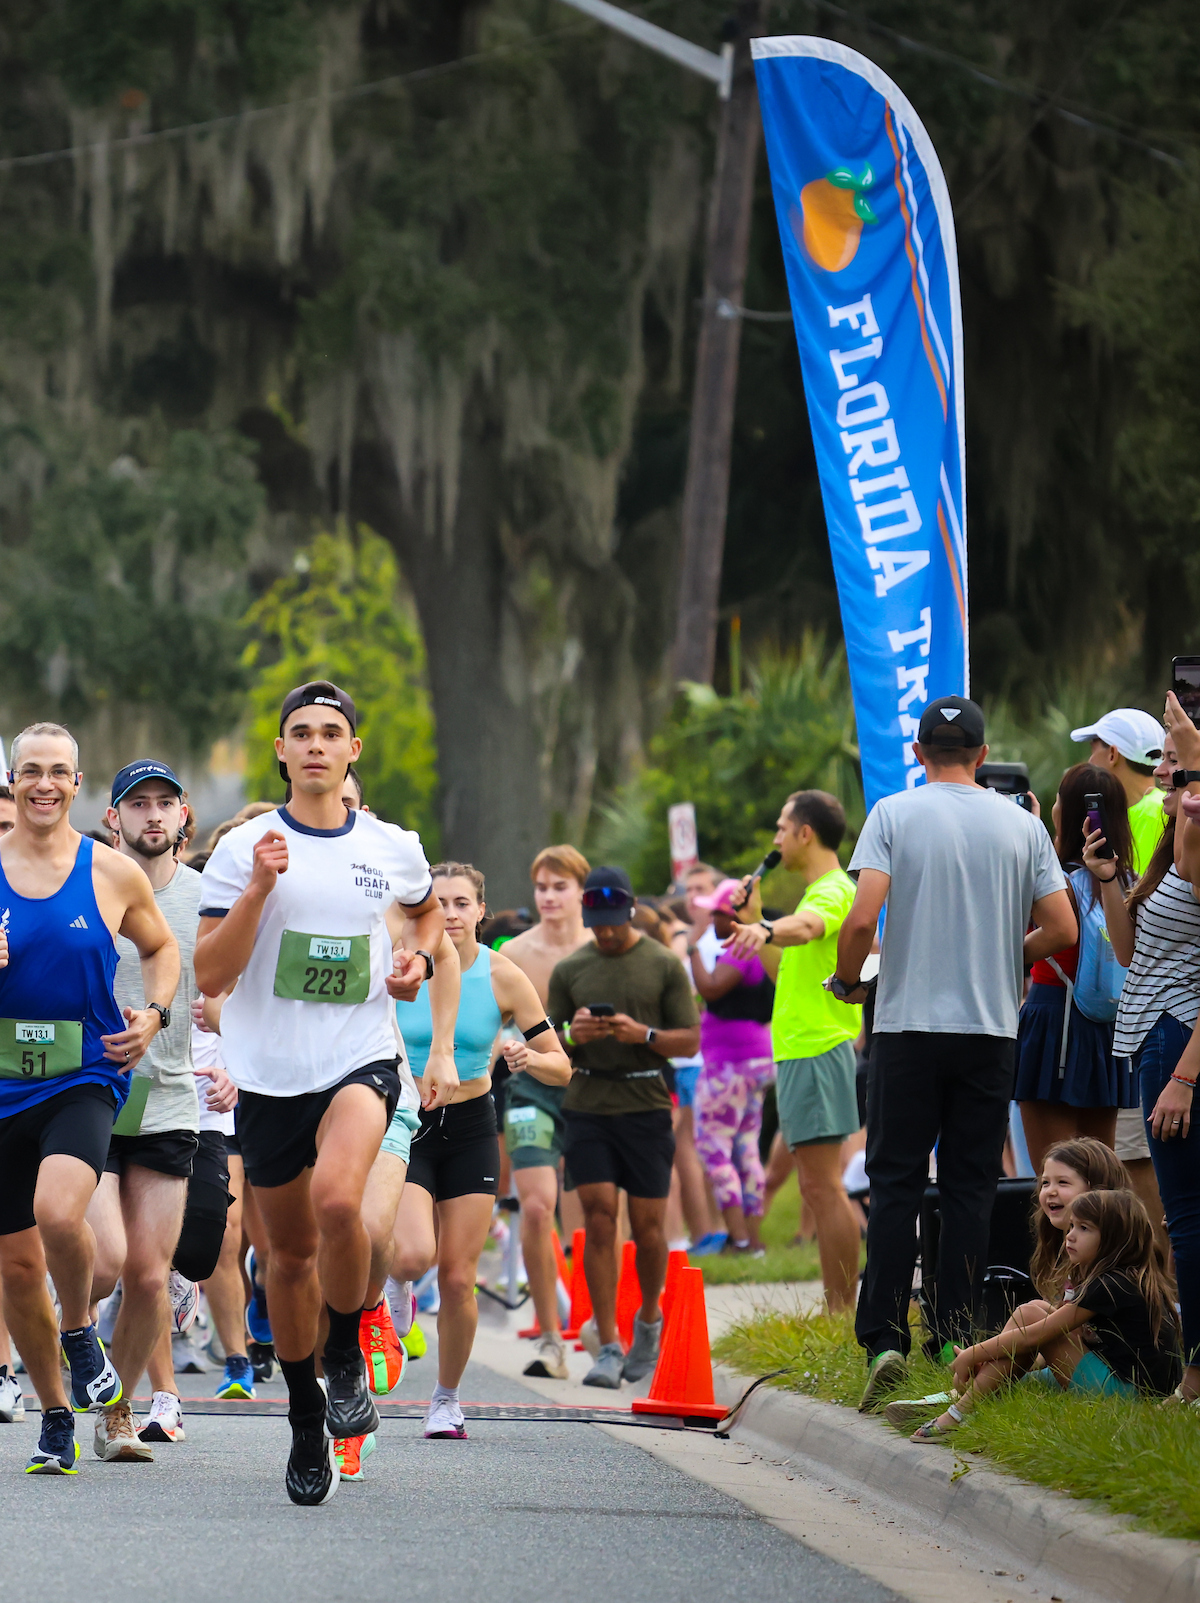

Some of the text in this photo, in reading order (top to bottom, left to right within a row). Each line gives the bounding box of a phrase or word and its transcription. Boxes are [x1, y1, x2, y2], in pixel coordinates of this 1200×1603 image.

[826, 292, 931, 598] FLORIDA
[355, 876, 391, 892] USAFA
[364, 888, 383, 900] CLUB
[316, 944, 330, 955] TW
[303, 966, 347, 997] 223
[21, 1029, 34, 1038] TW
[21, 1050, 47, 1077] 51
